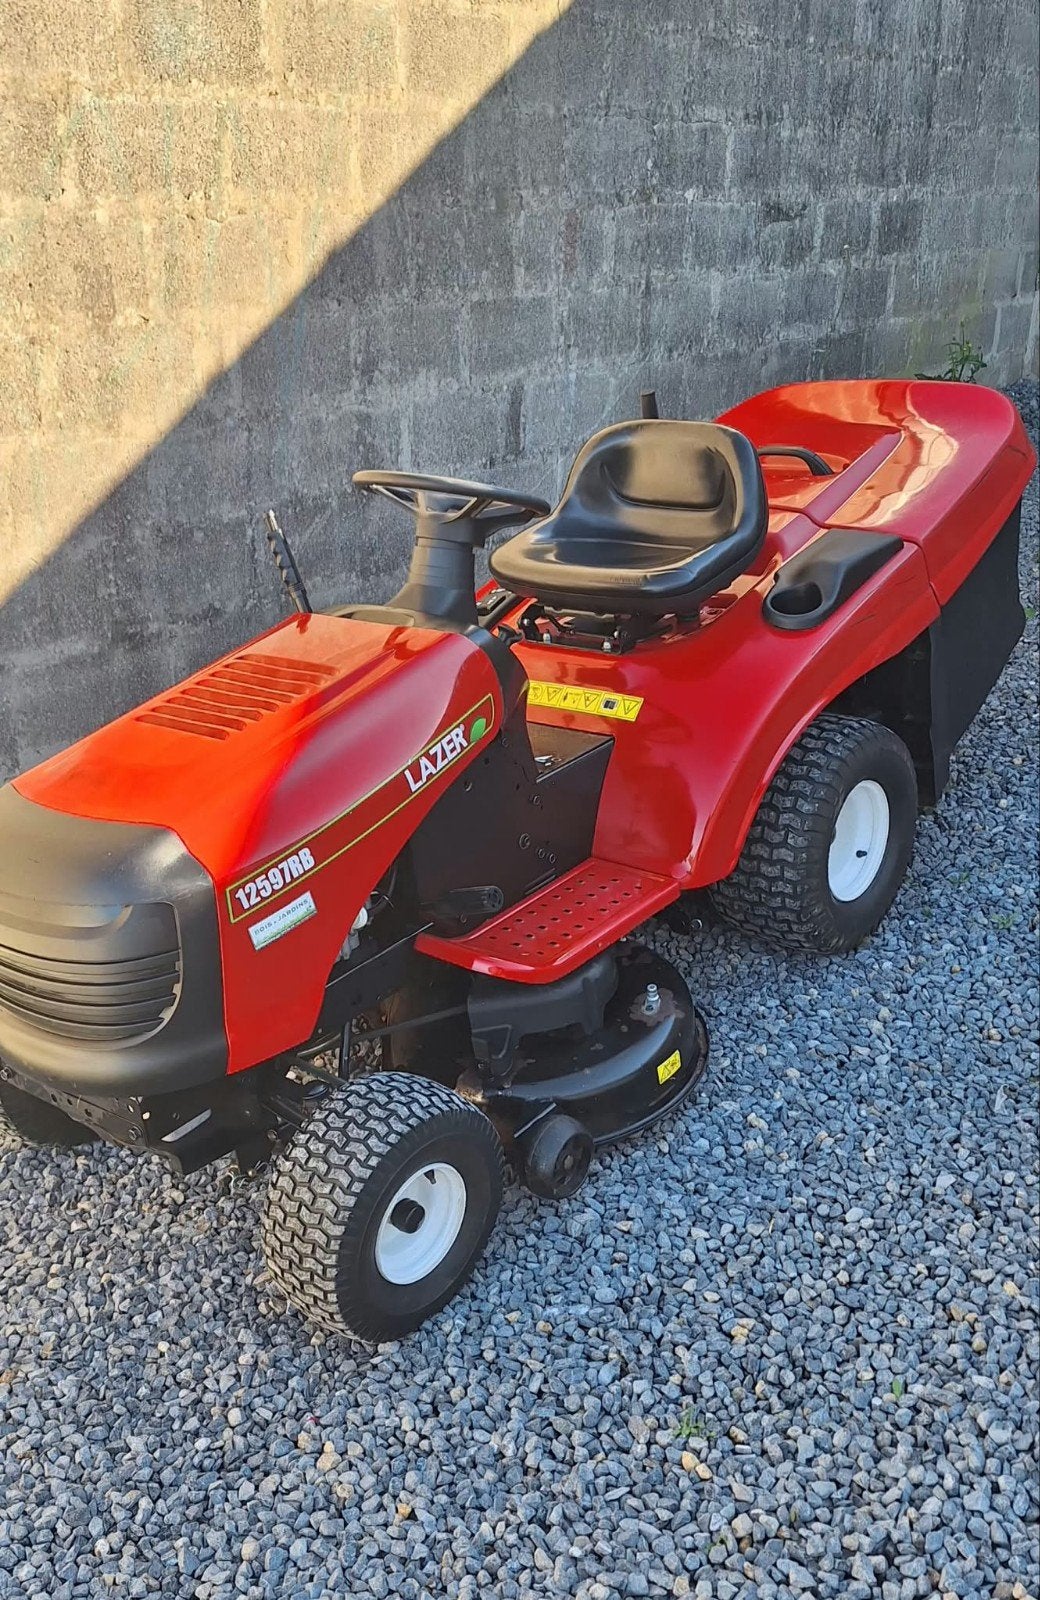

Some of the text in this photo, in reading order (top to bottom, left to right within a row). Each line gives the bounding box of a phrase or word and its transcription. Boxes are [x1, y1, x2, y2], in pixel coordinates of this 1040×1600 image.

[404, 723, 468, 793] LAZER
[235, 847, 315, 910] 12597RB
[278, 898, 309, 921] JARDINS
